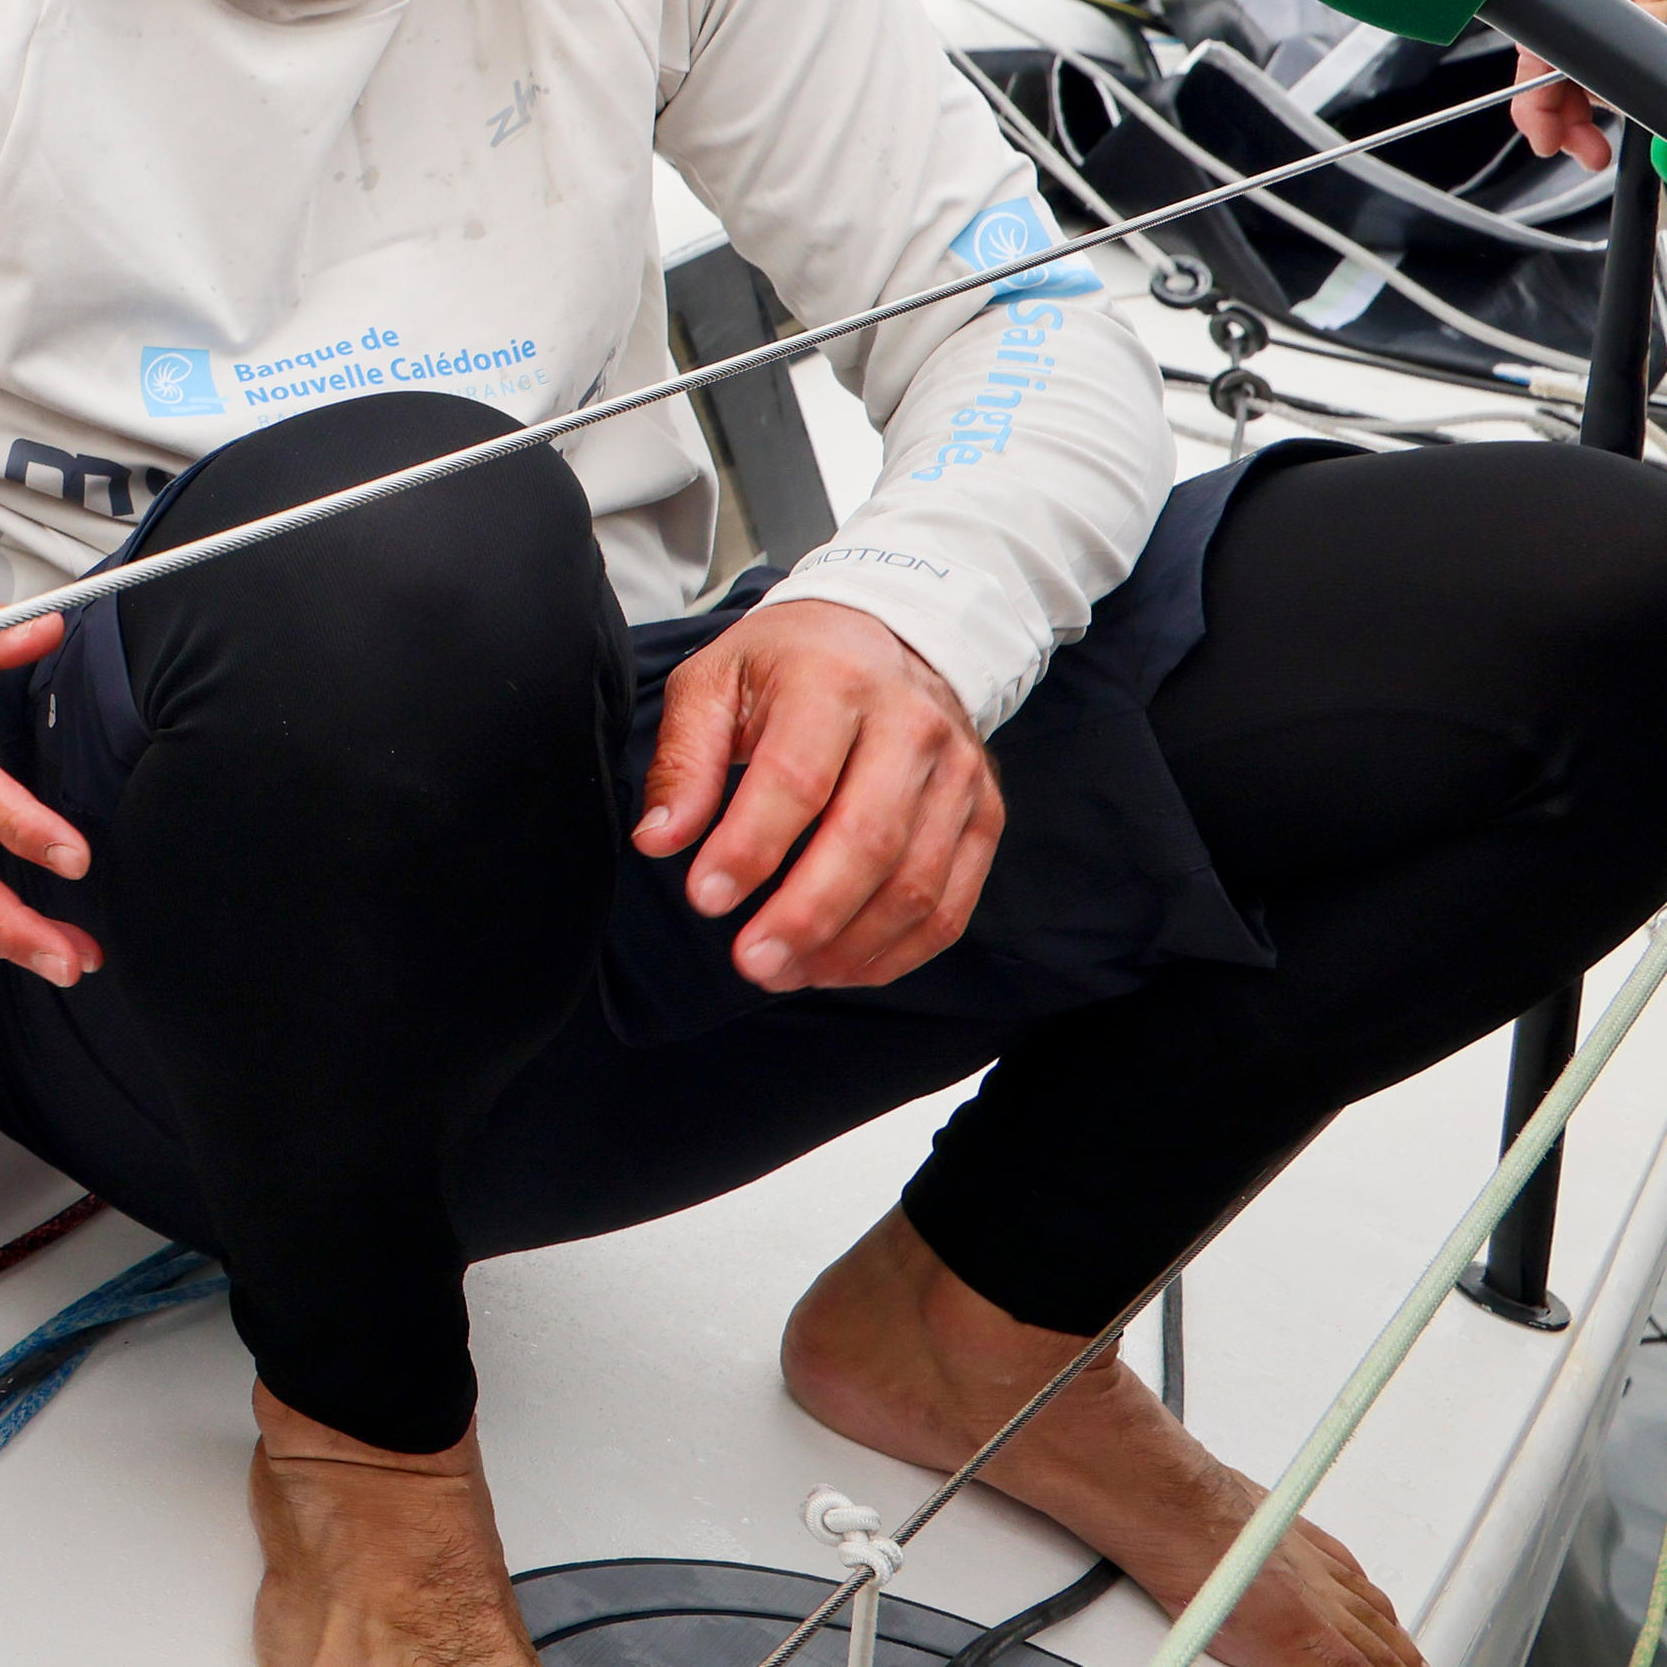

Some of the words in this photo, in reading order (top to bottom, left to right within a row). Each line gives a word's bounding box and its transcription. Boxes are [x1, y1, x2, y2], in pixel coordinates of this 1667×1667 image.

[233, 339, 354, 382] Banque
[361, 327, 400, 350] de
[244, 363, 384, 406] Nouvelle
[390, 338, 537, 381] Calédonie
[951, 303, 1064, 427] Sailing
